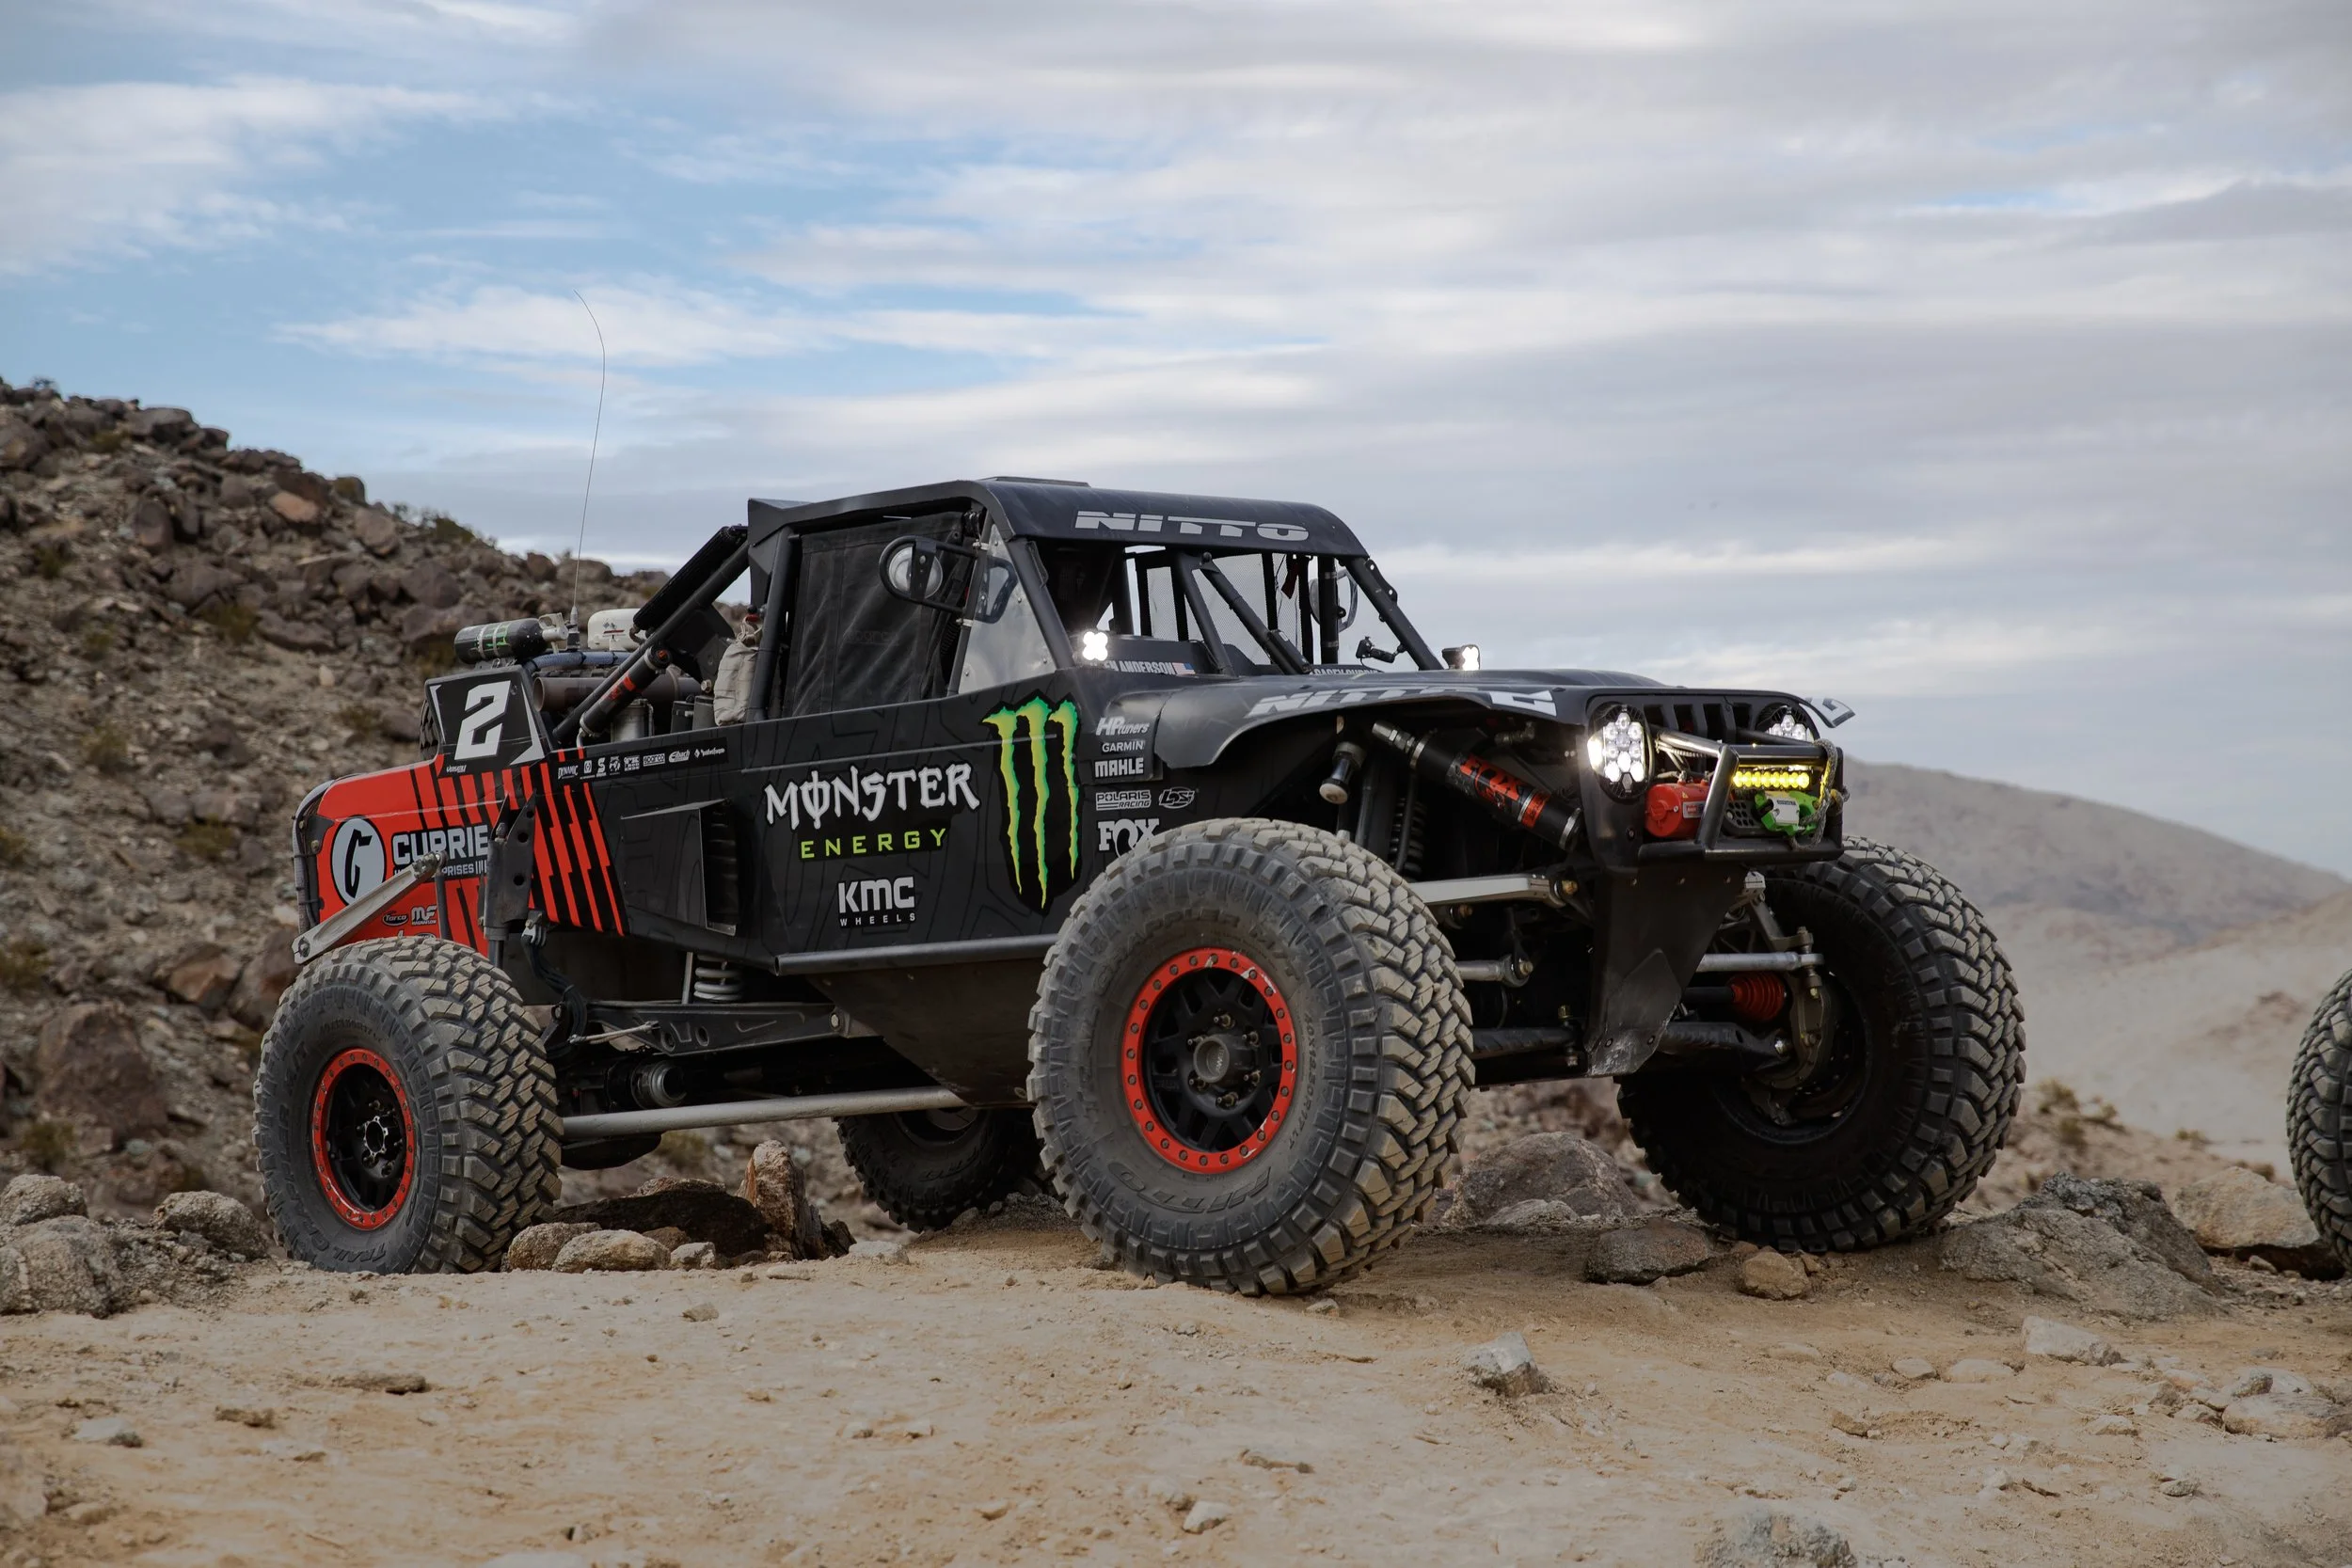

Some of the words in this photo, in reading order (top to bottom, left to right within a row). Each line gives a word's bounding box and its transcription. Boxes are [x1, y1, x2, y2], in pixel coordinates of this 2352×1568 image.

[1075, 511, 1309, 541] NITTO
[1119, 660, 1176, 675] ANDERSON
[454, 680, 511, 760] 2
[1102, 740, 1145, 752] GARMIN
[1094, 757, 1144, 778] MAHLE
[765, 763, 980, 830] MONSTER
[1097, 791, 1150, 802] POLARIS
[1119, 800, 1150, 808] RACING
[392, 825, 488, 865] CURRIE
[801, 828, 946, 859] ENERGY
[1098, 818, 1159, 857] FOX
[838, 877, 914, 913] KMC
[840, 912, 915, 927] WHEELS
